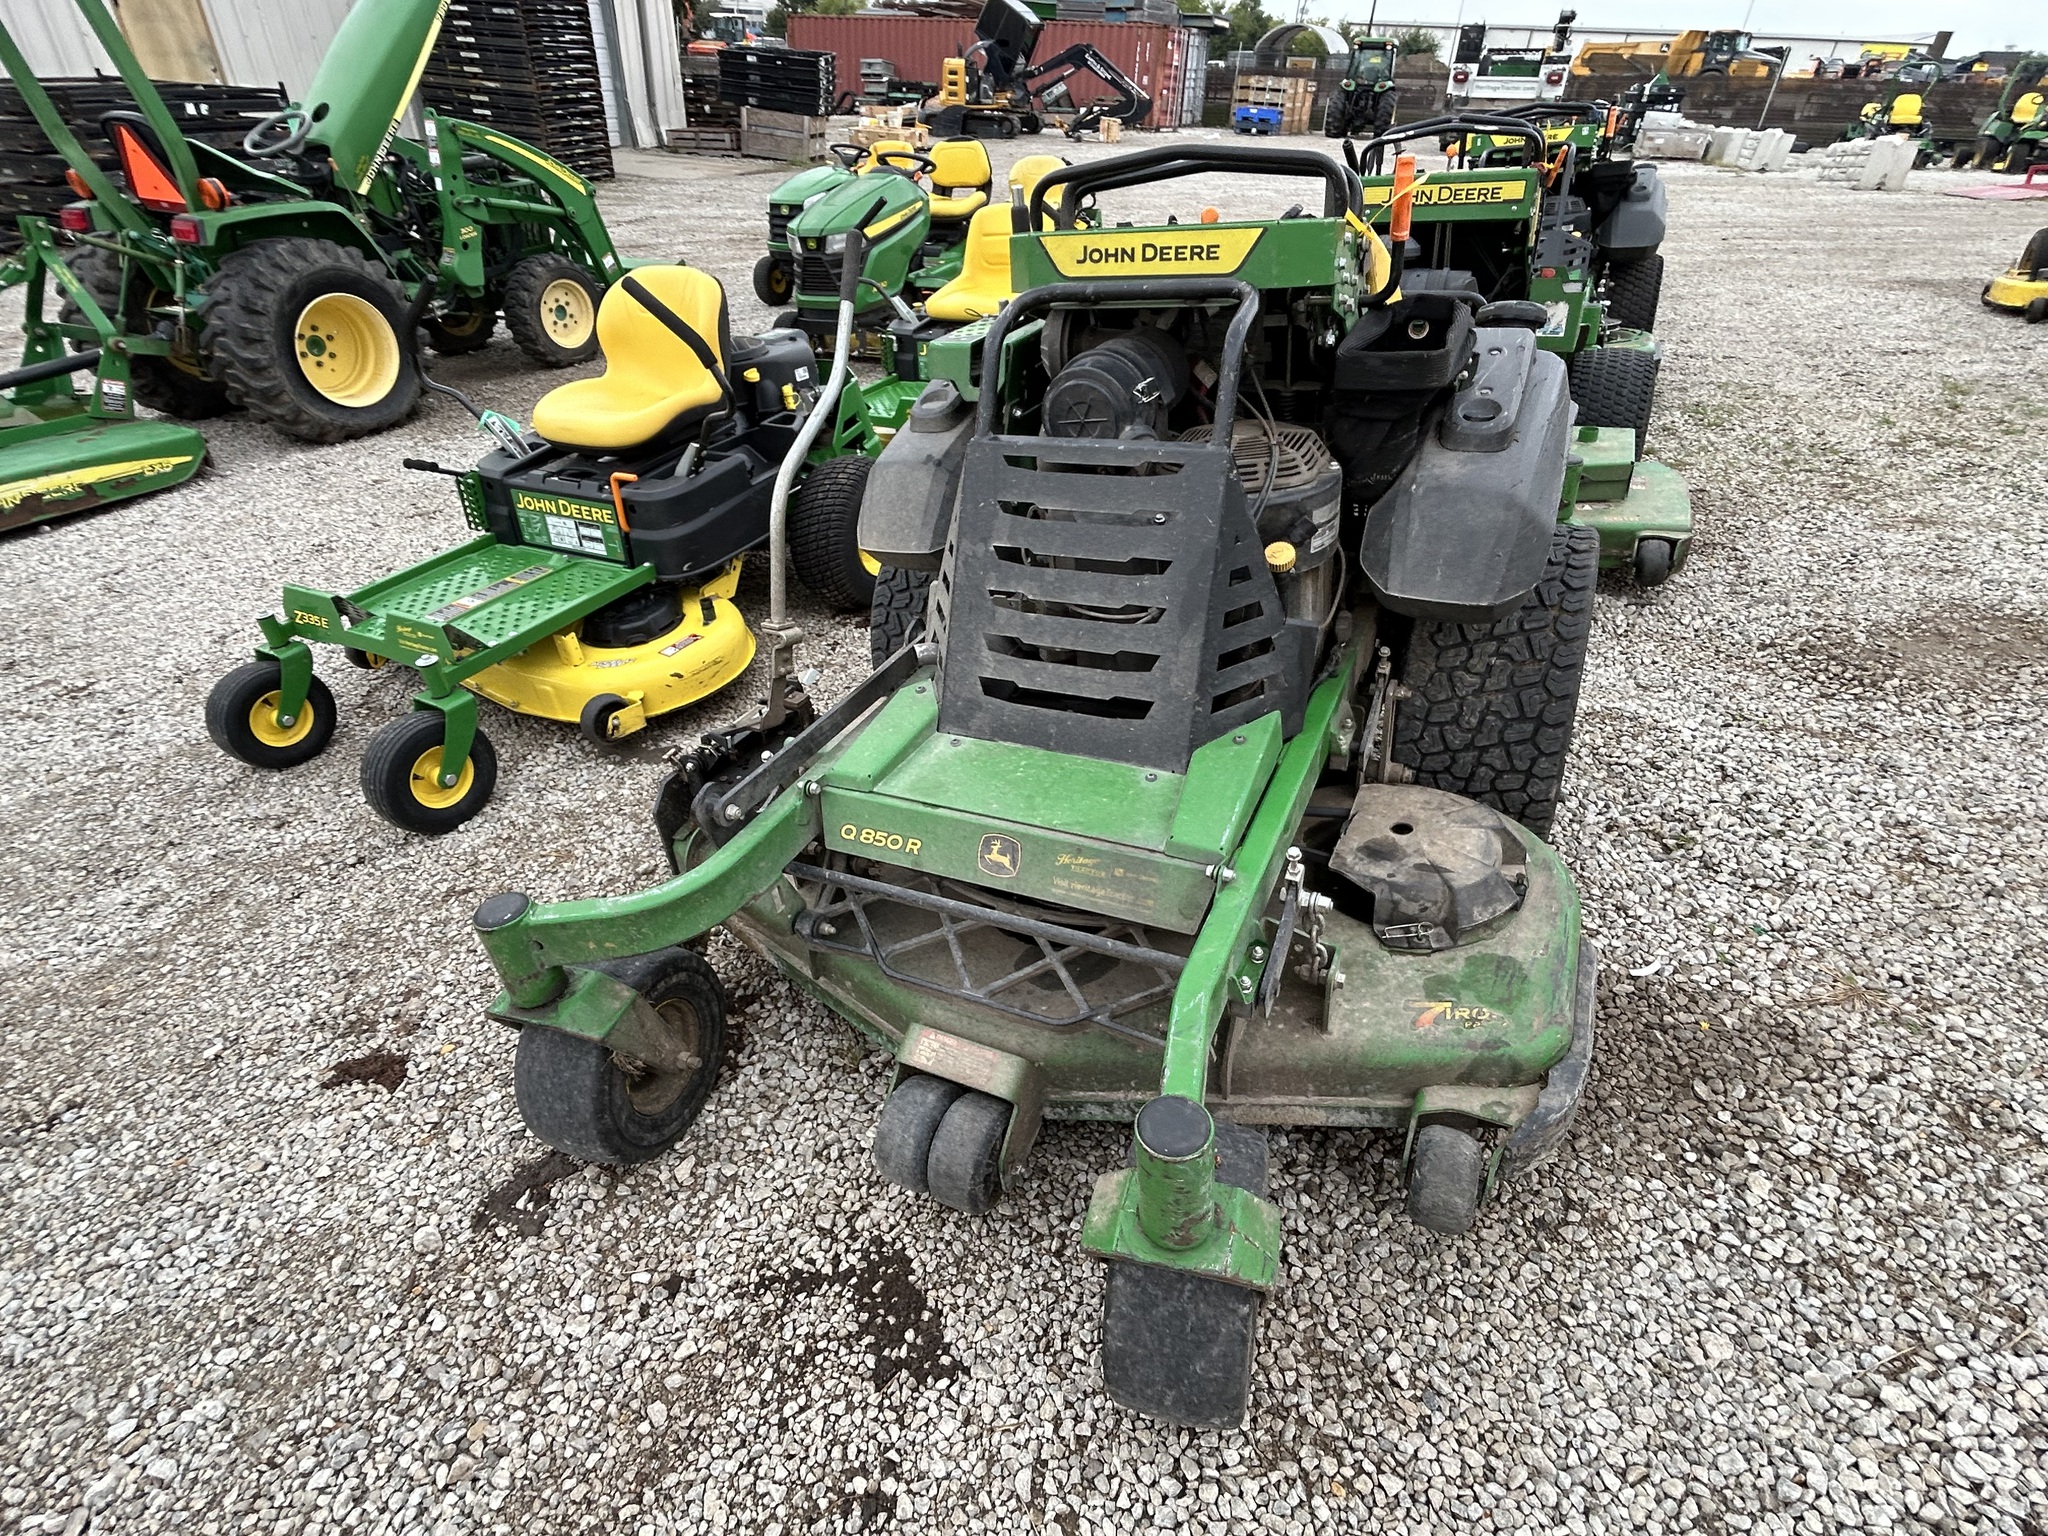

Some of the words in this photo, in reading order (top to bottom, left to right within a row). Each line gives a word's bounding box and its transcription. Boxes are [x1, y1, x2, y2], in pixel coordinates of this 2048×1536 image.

[1381, 187, 1433, 204] JHN
[1438, 186, 1503, 203] DEERE
[1076, 245, 1135, 264] JOHN
[1141, 243, 1221, 262] DEERE
[516, 493, 557, 514] JOHN
[558, 499, 615, 524] DEERE
